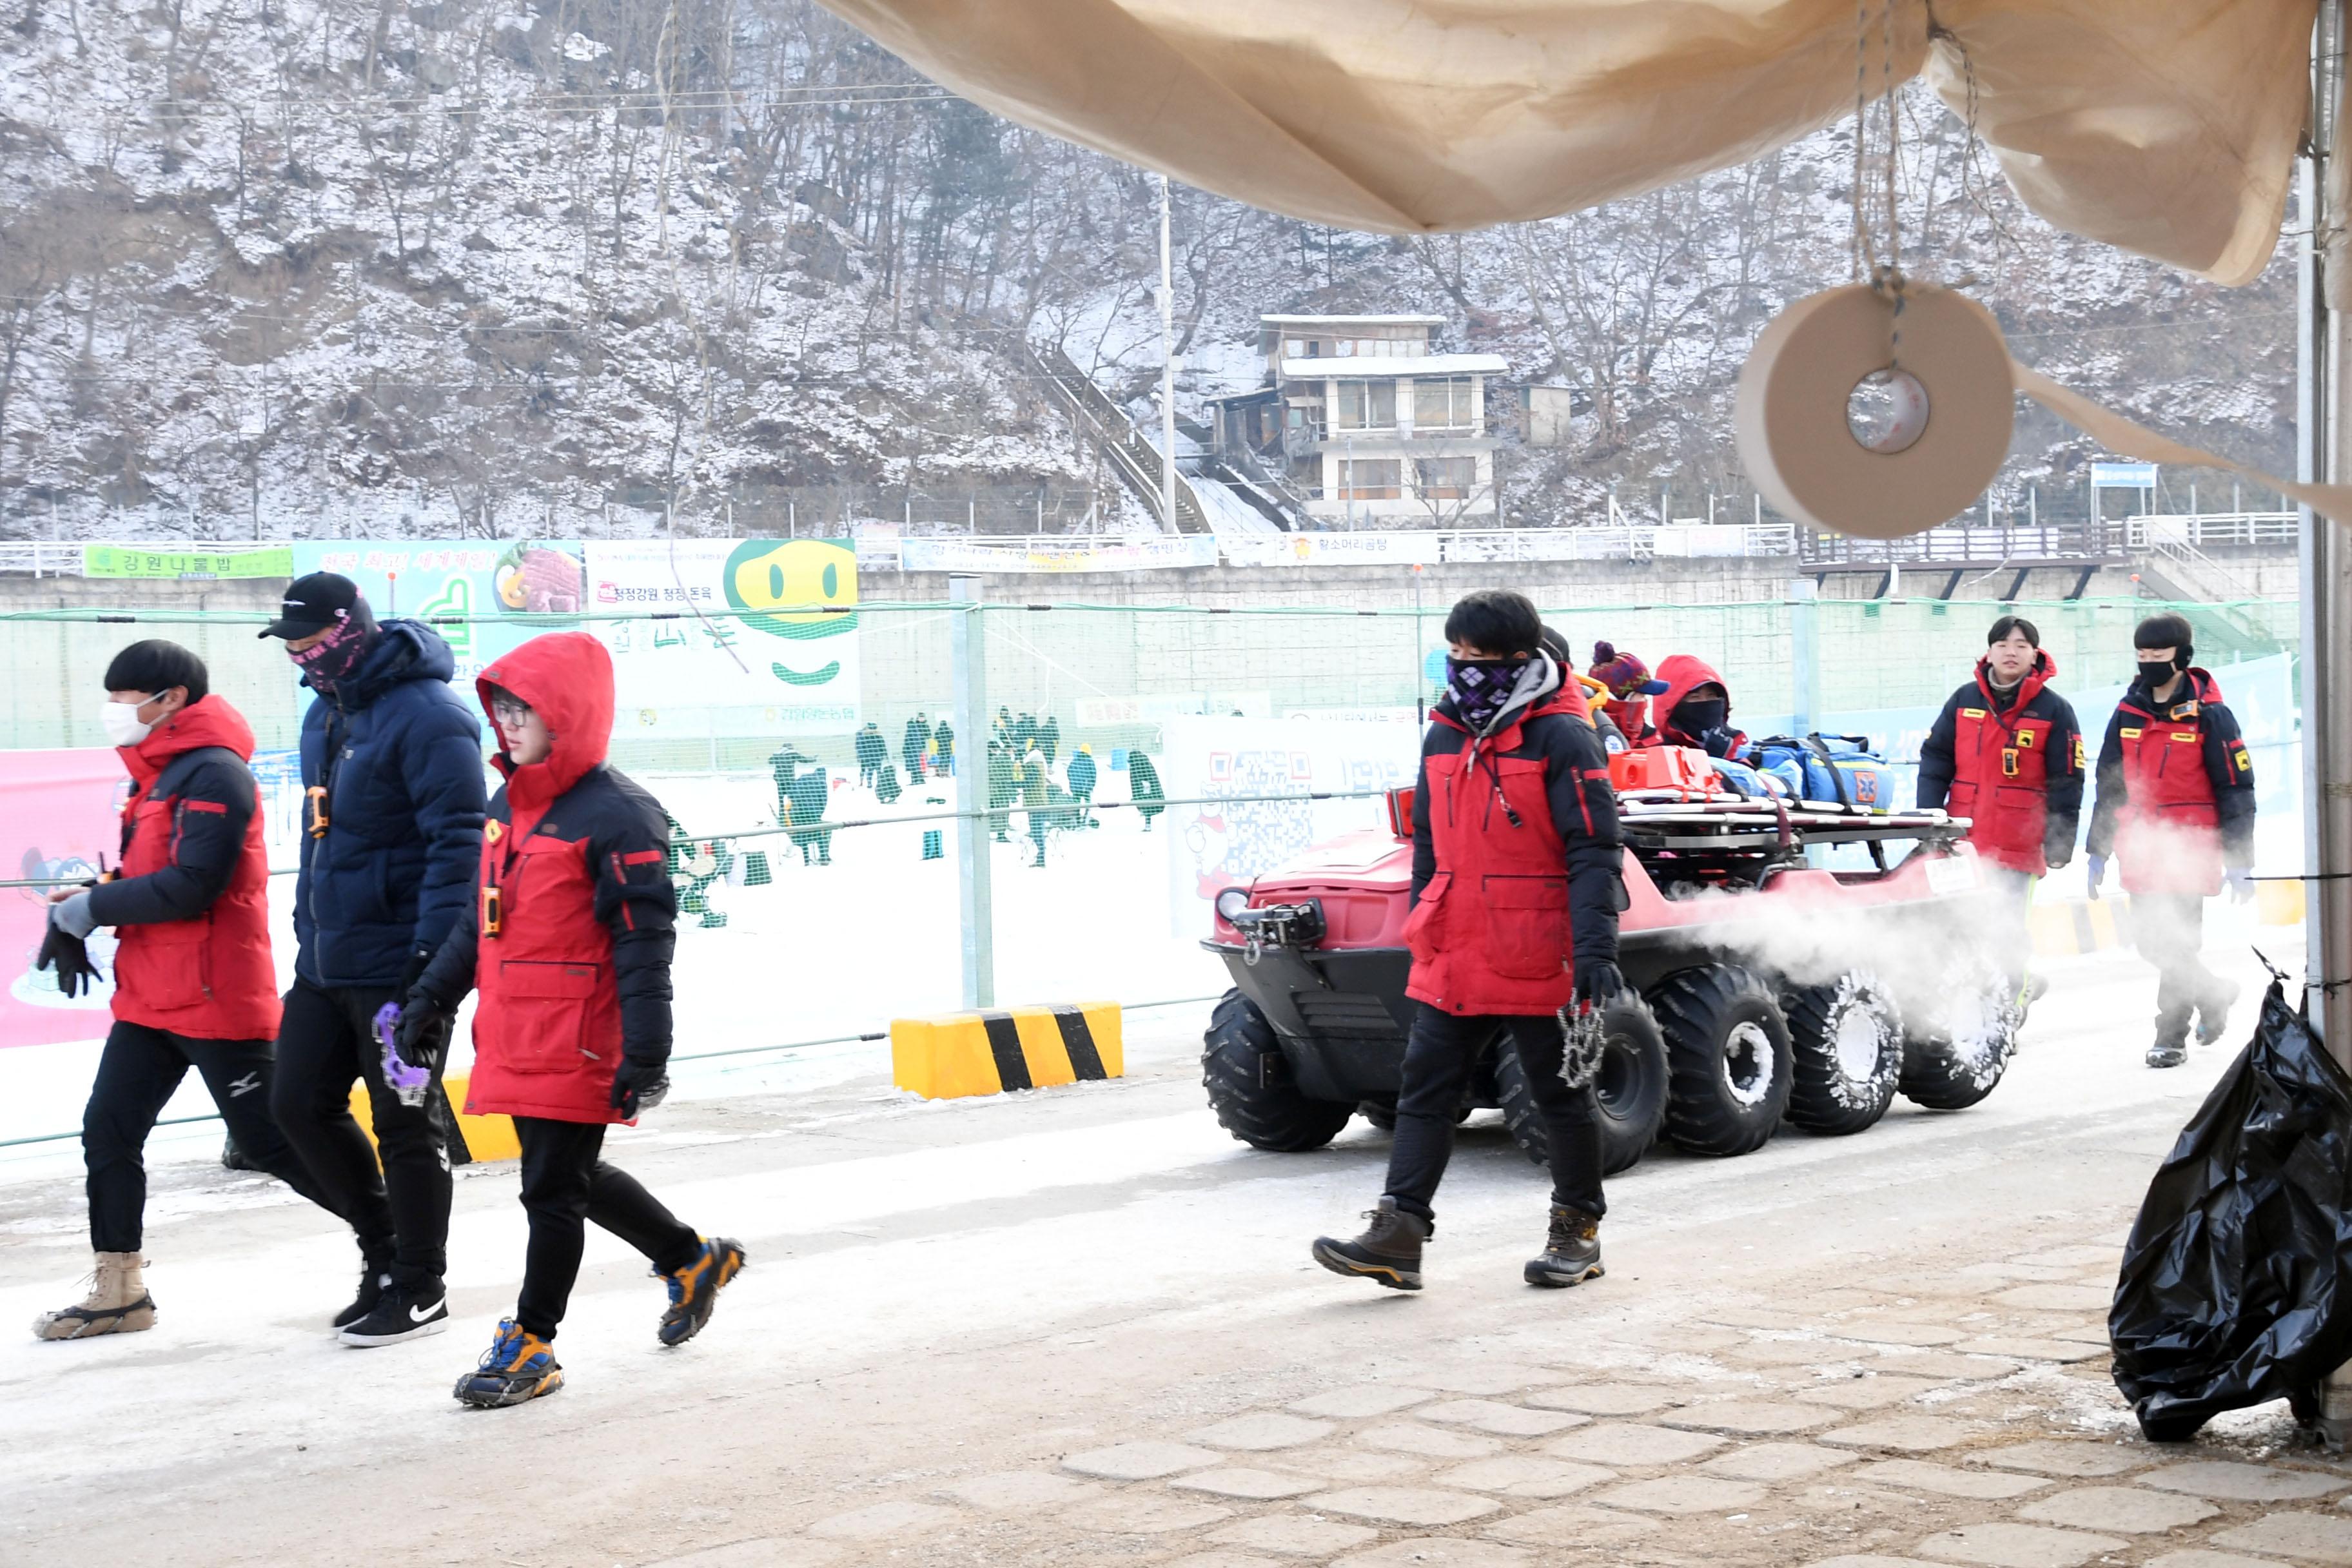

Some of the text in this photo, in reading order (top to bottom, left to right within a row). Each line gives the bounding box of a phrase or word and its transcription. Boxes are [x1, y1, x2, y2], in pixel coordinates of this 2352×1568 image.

[1318, 538, 1387, 551] 황소머리곰탕
[123, 555, 230, 571] 강원나물밥
[614, 587, 658, 602] 청정강원
[691, 587, 711, 601] 돈육
